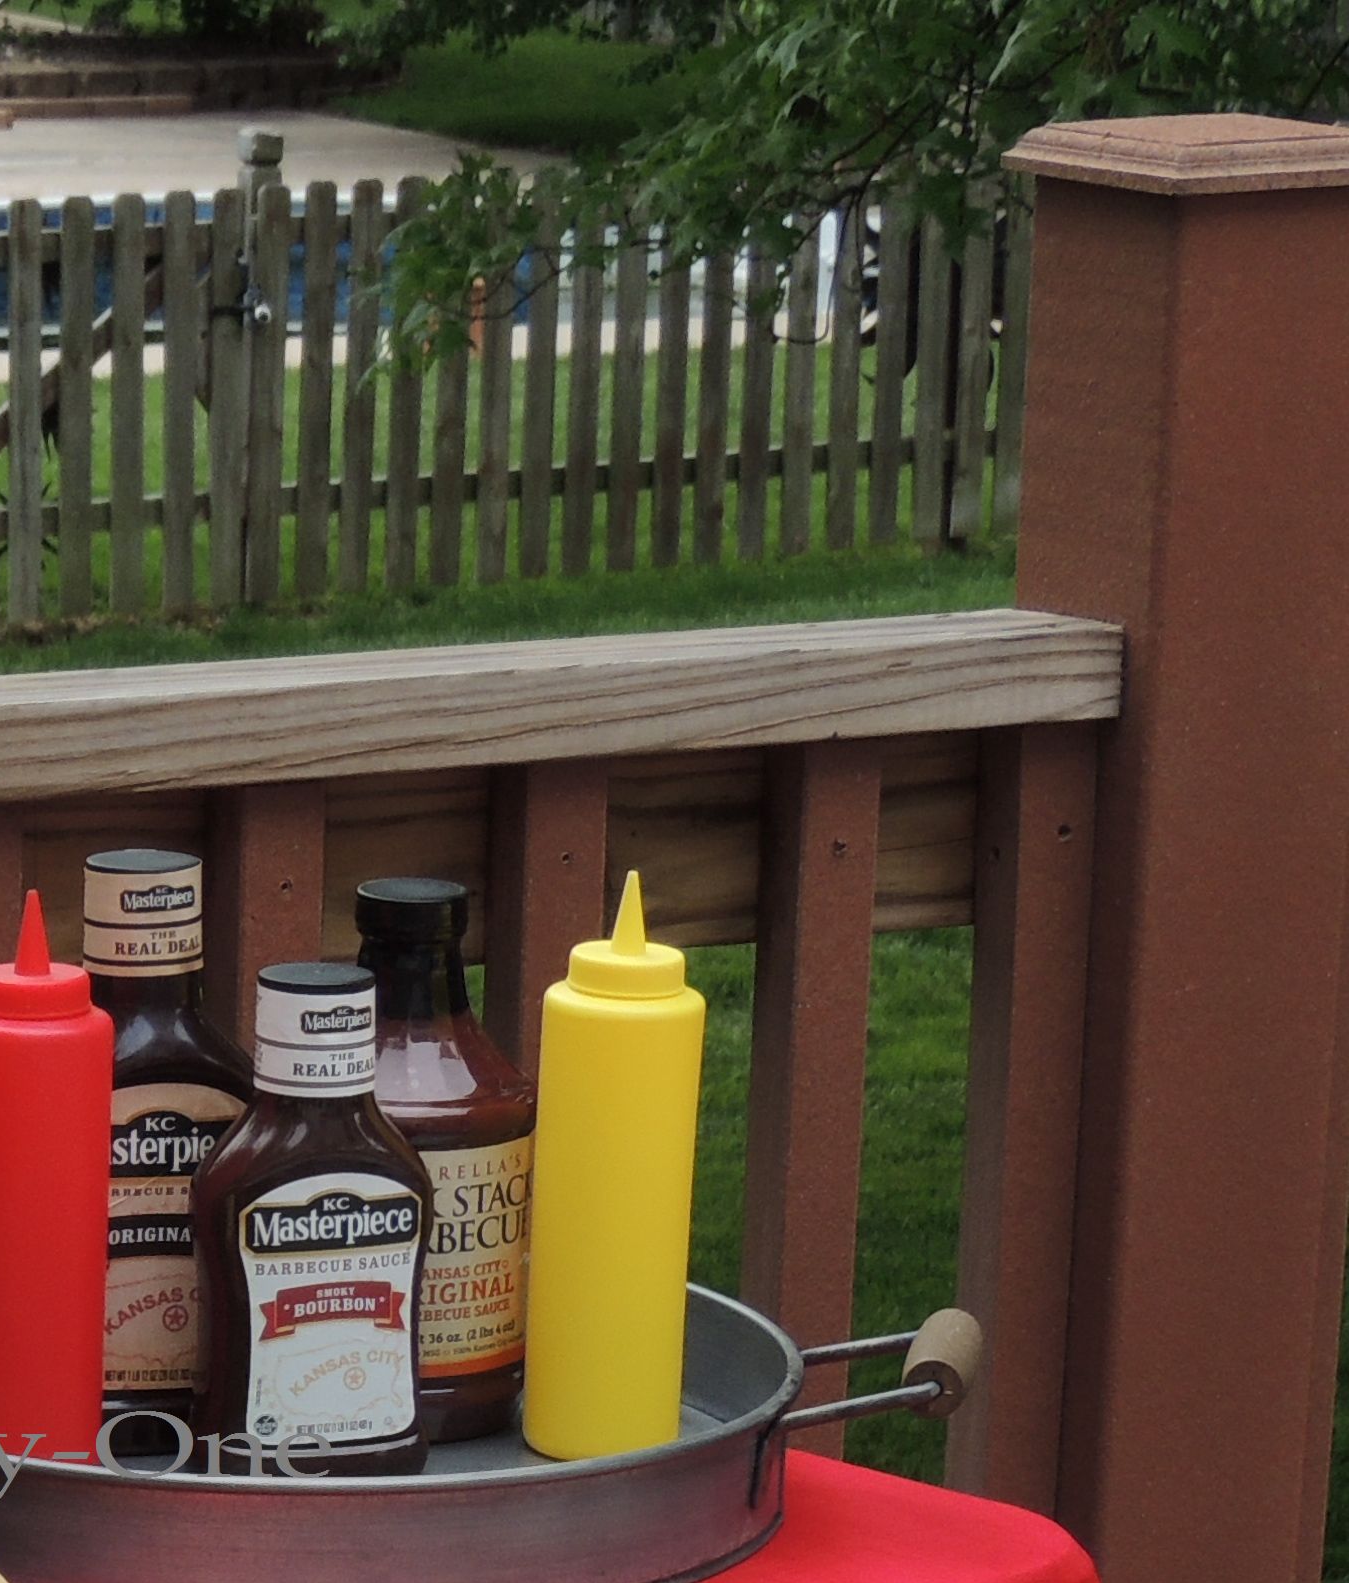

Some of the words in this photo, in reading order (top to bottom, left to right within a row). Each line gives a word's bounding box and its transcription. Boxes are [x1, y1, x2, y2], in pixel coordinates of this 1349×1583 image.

[123, 889, 193, 910] Masterpiece
[150, 931, 177, 940] THE
[114, 941, 162, 956] REAL
[304, 1010, 371, 1031] Masterpiece
[329, 1052, 356, 1062] THE
[293, 1063, 341, 1078] REAL
[145, 1116, 177, 1132] KC
[111, 1126, 217, 1173] sterpie
[429, 1154, 522, 1181] RELLA'S
[323, 1196, 351, 1212] KC
[253, 1204, 414, 1248] Masterpiece
[428, 1210, 526, 1255] BECUE
[255, 1259, 353, 1277] BARBECUE
[358, 1251, 412, 1271] SAUCE
[316, 1286, 357, 1299] SMOKY
[420, 1272, 515, 1306] IGINAL
[104, 1286, 184, 1336] KANSAS
[293, 1296, 377, 1319] BOURBON
[420, 1306, 472, 1322] BECUE
[428, 1333, 444, 1345] 36
[289, 1351, 363, 1397] KANSAS
[366, 1349, 406, 1367] CITY
